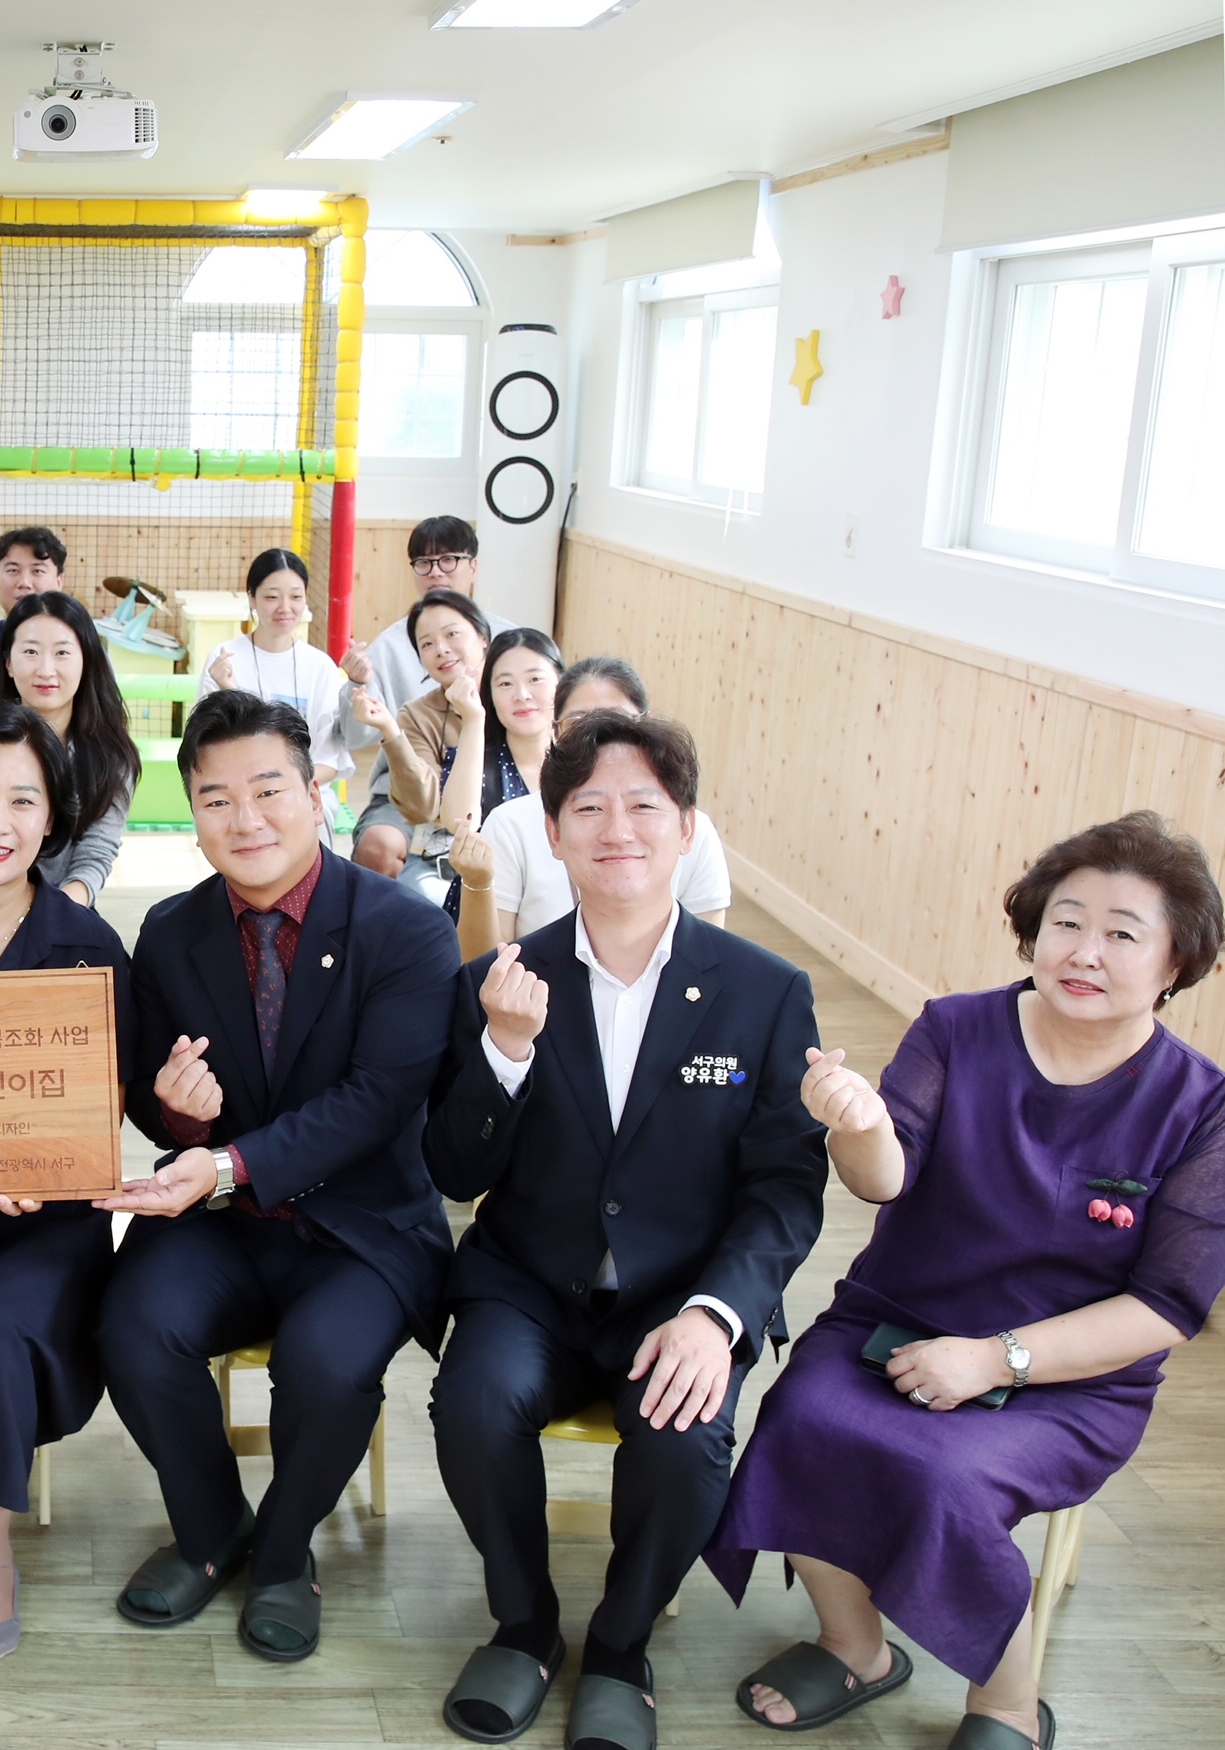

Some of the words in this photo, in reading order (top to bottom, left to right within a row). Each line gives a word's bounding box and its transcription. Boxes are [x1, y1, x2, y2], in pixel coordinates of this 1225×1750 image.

[50, 1025, 89, 1047] 사업
[691, 1055, 738, 1070] 서구의원
[680, 1066, 729, 1085] 양유환
[50, 1157, 76, 1170] 서구
